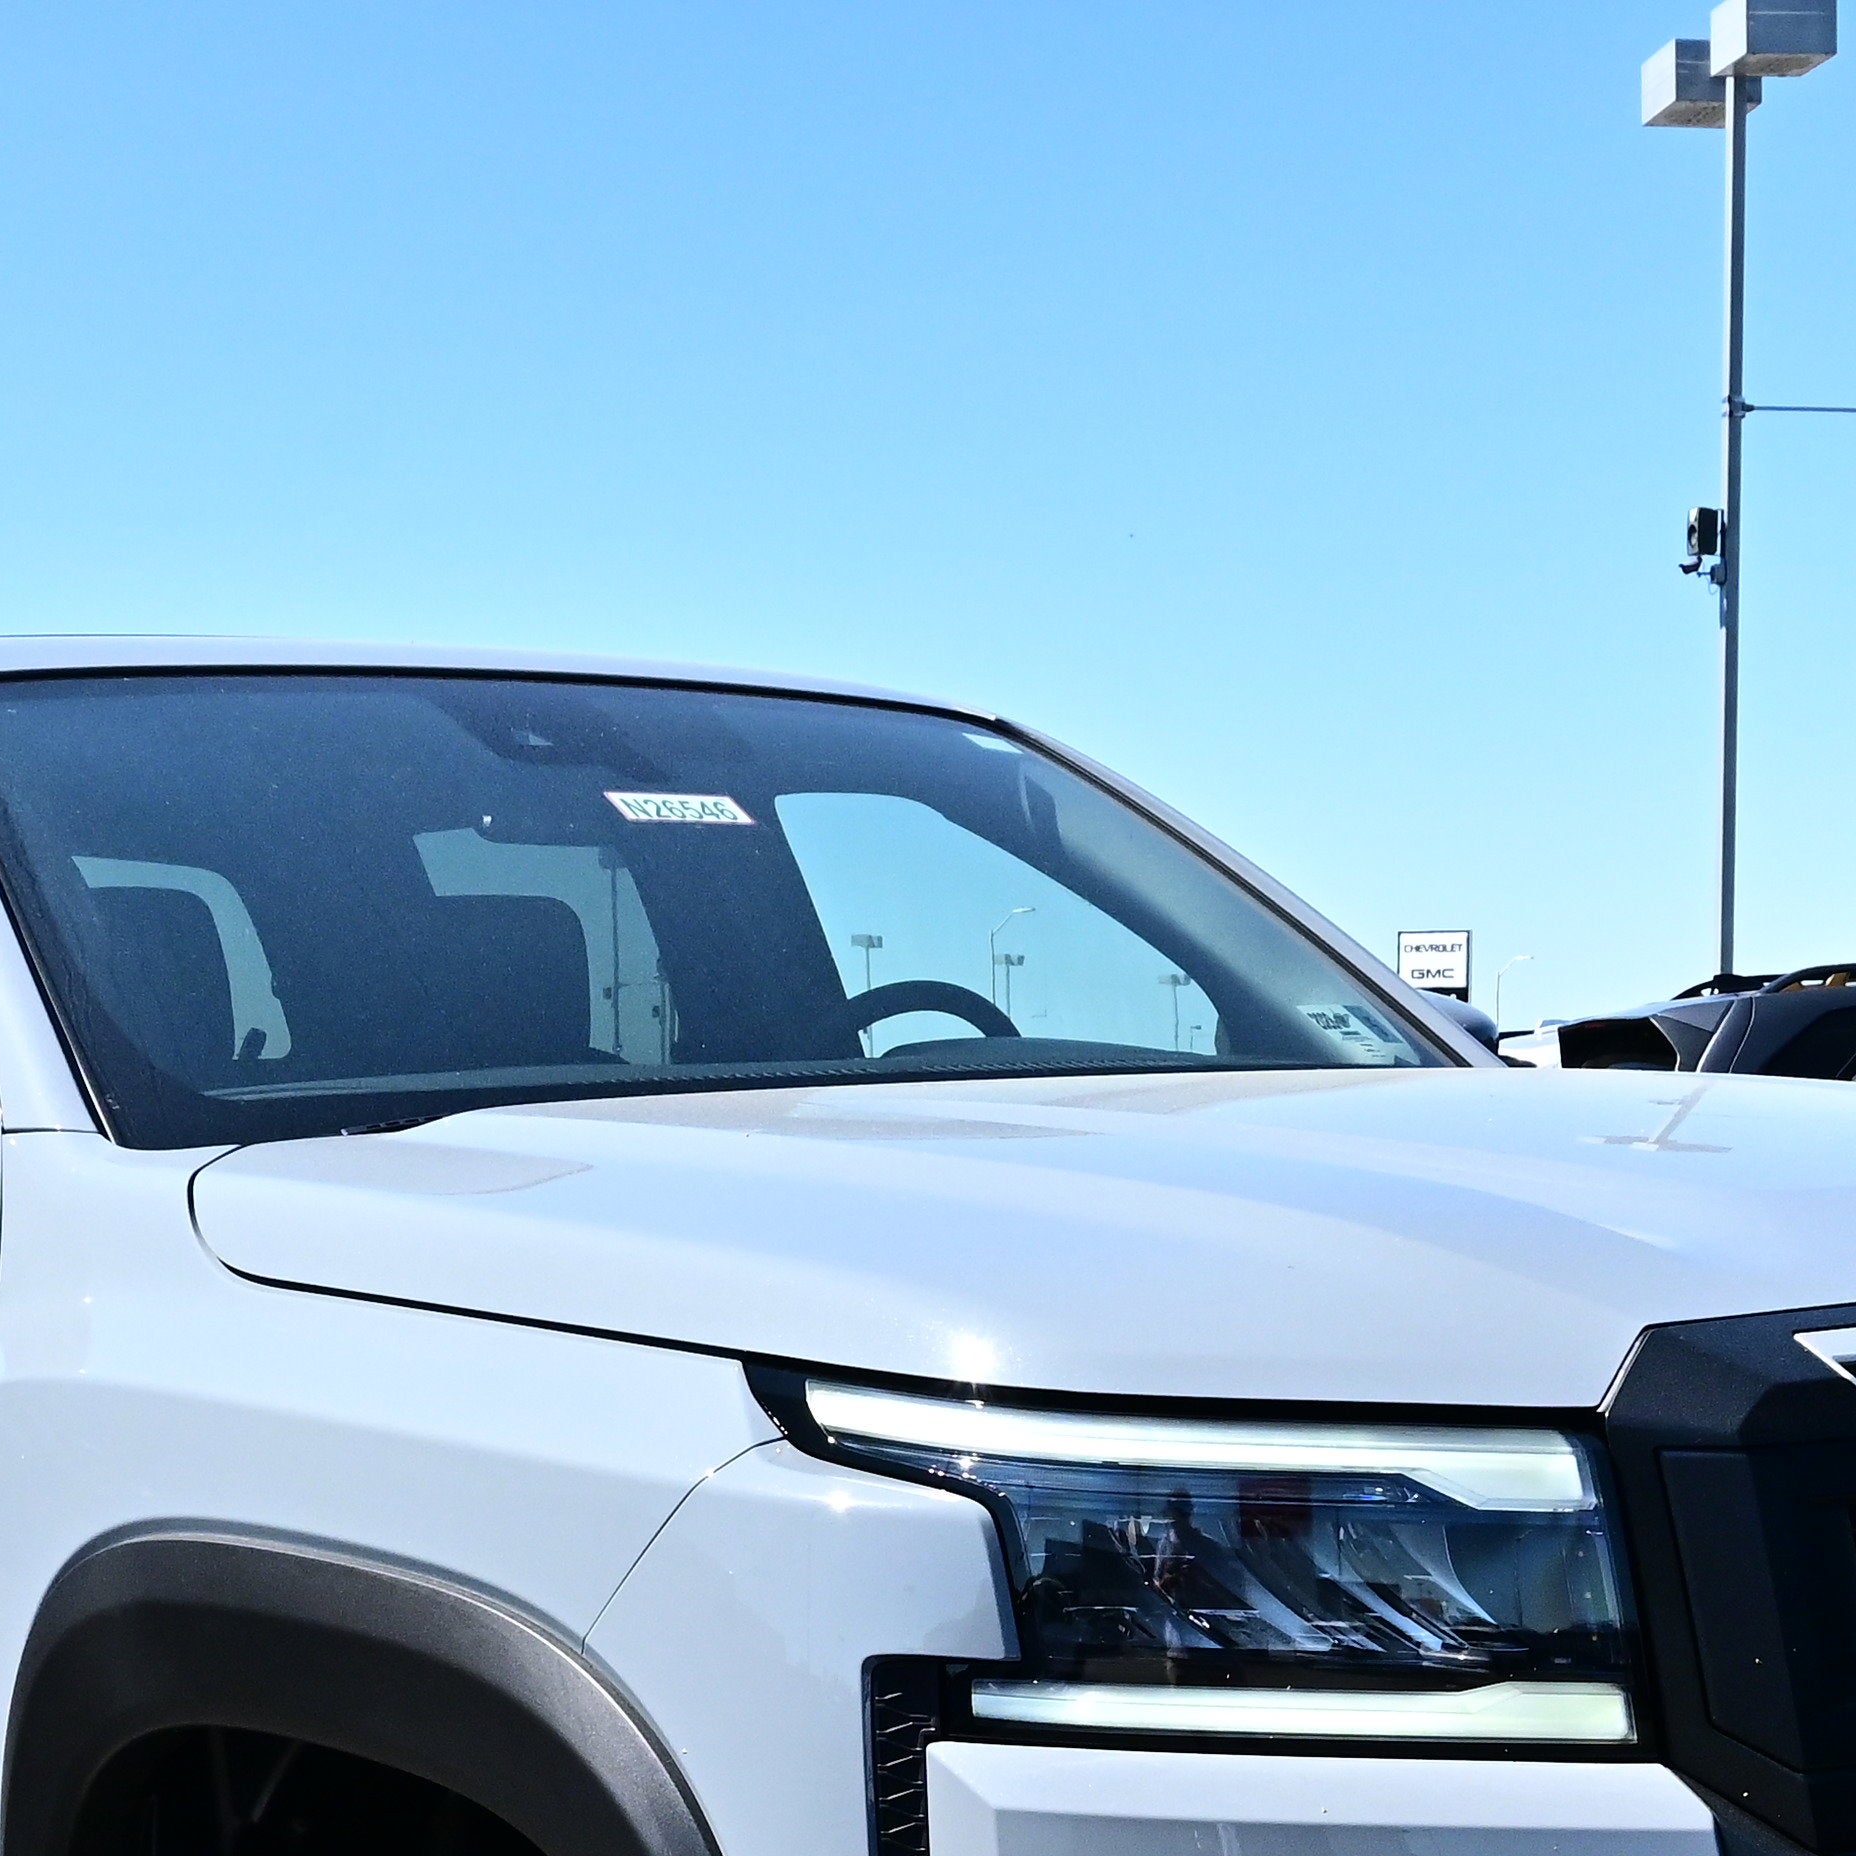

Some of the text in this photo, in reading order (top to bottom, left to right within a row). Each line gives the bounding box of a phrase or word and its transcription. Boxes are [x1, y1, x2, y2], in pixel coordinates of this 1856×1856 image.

[619, 798, 738, 821] N26546
[1404, 943, 1463, 953] CHEVROLET
[1411, 968, 1454, 979] GMC
